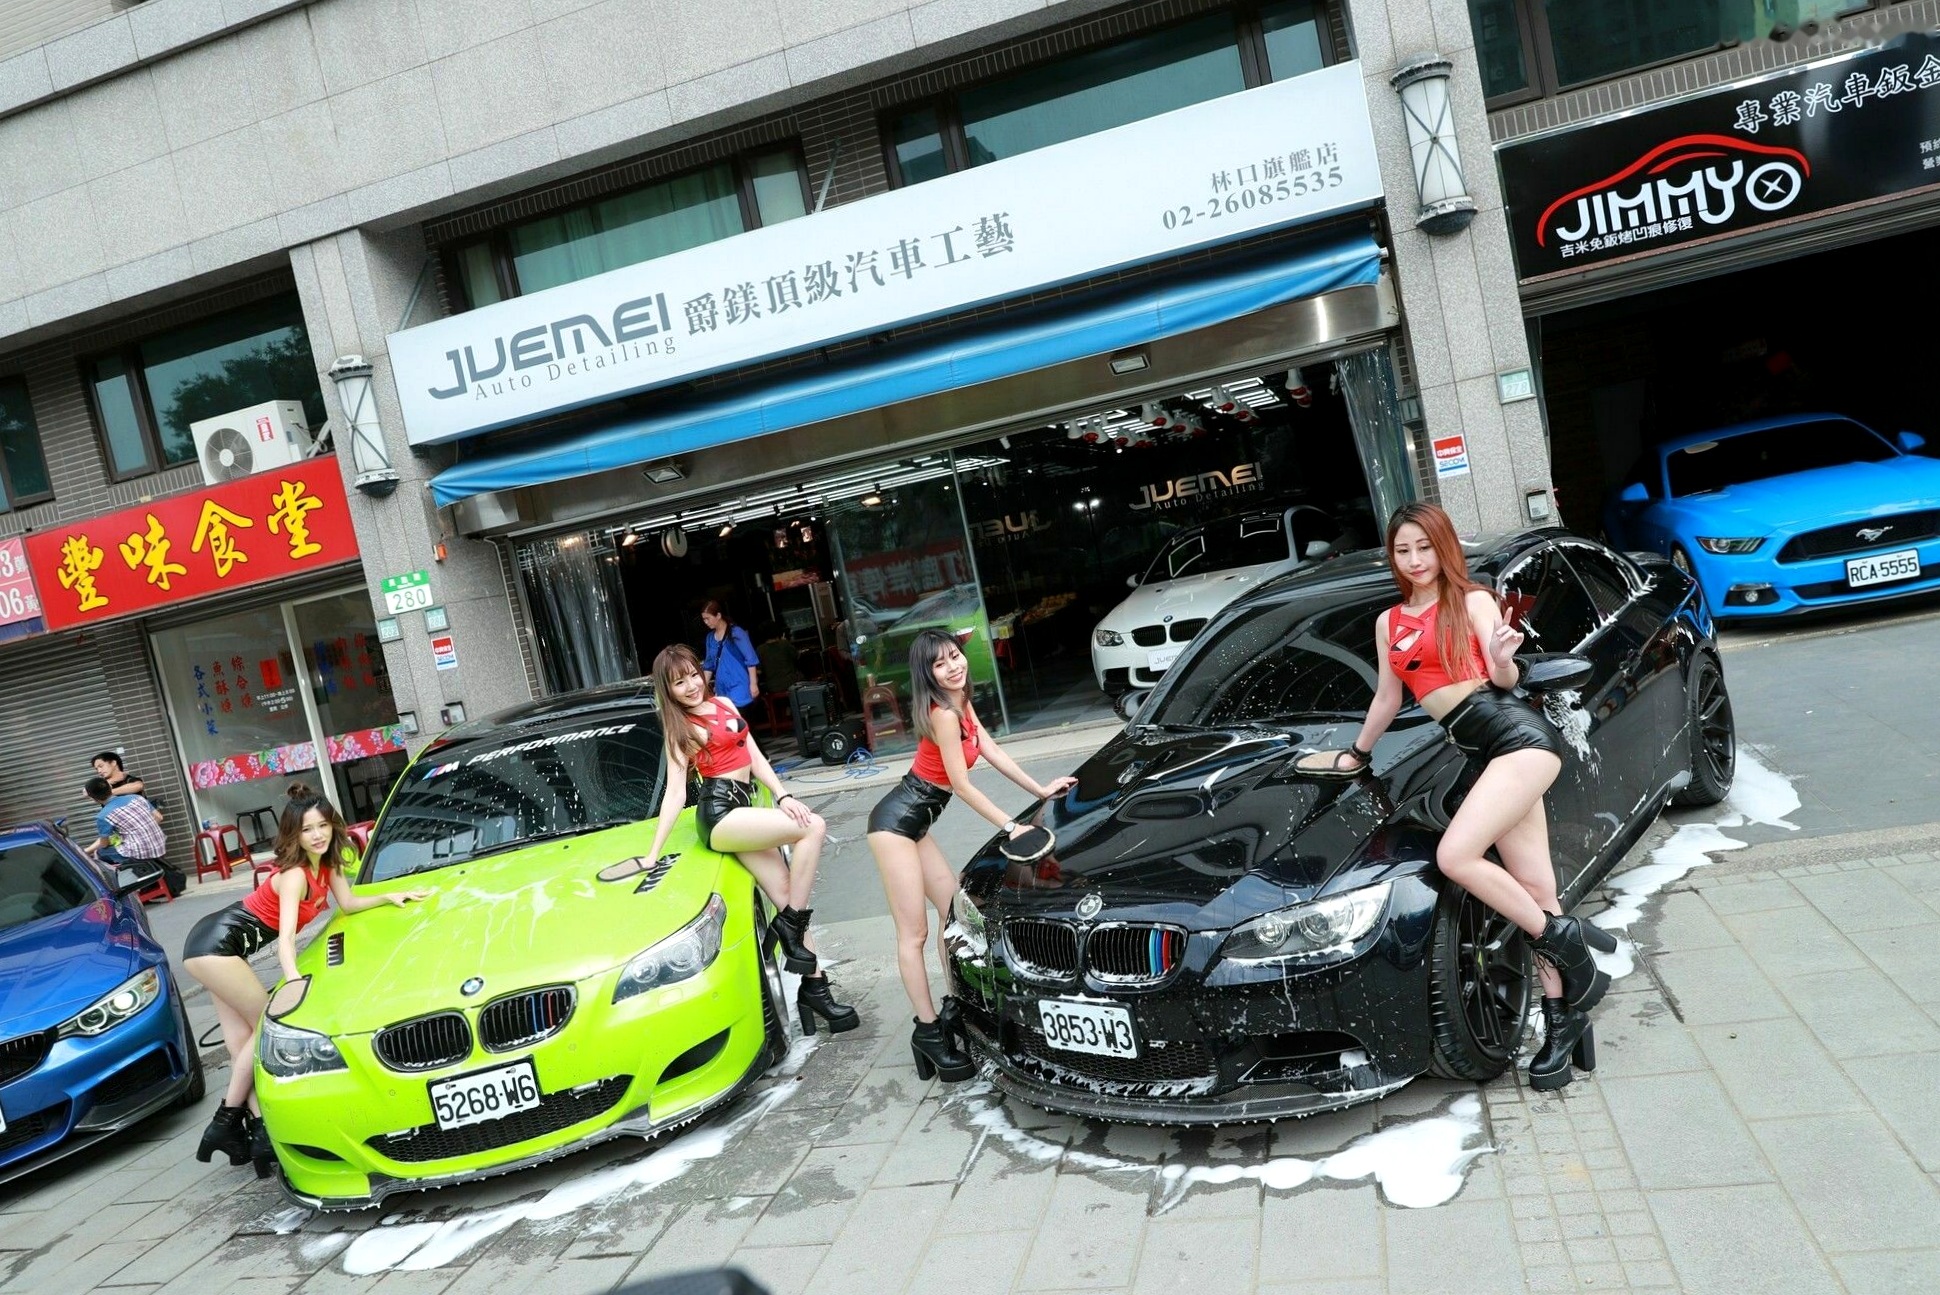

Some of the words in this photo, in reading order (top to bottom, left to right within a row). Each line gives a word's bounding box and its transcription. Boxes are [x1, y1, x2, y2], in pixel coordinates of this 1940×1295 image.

[1210, 142, 1338, 194] 林口旗艦店
[1162, 165, 1344, 230] 02-26085535
[1559, 215, 1694, 259] 吉米免鈑烤凹痕修復
[682, 212, 1015, 336] 爵鎂頂級汽車工藝
[427, 292, 672, 400] JUEMEI
[475, 374, 532, 400] Auto
[546, 336, 676, 382] Detailing
[1128, 461, 1264, 510] JUEMEI
[1154, 498, 1187, 511] Auto
[1196, 481, 1265, 502] Detailing
[57, 480, 325, 613] 豐味食堂
[392, 588, 427, 611] 280
[193, 664, 219, 736] 各式小菜
[466, 723, 637, 767] PERFORMANCE
